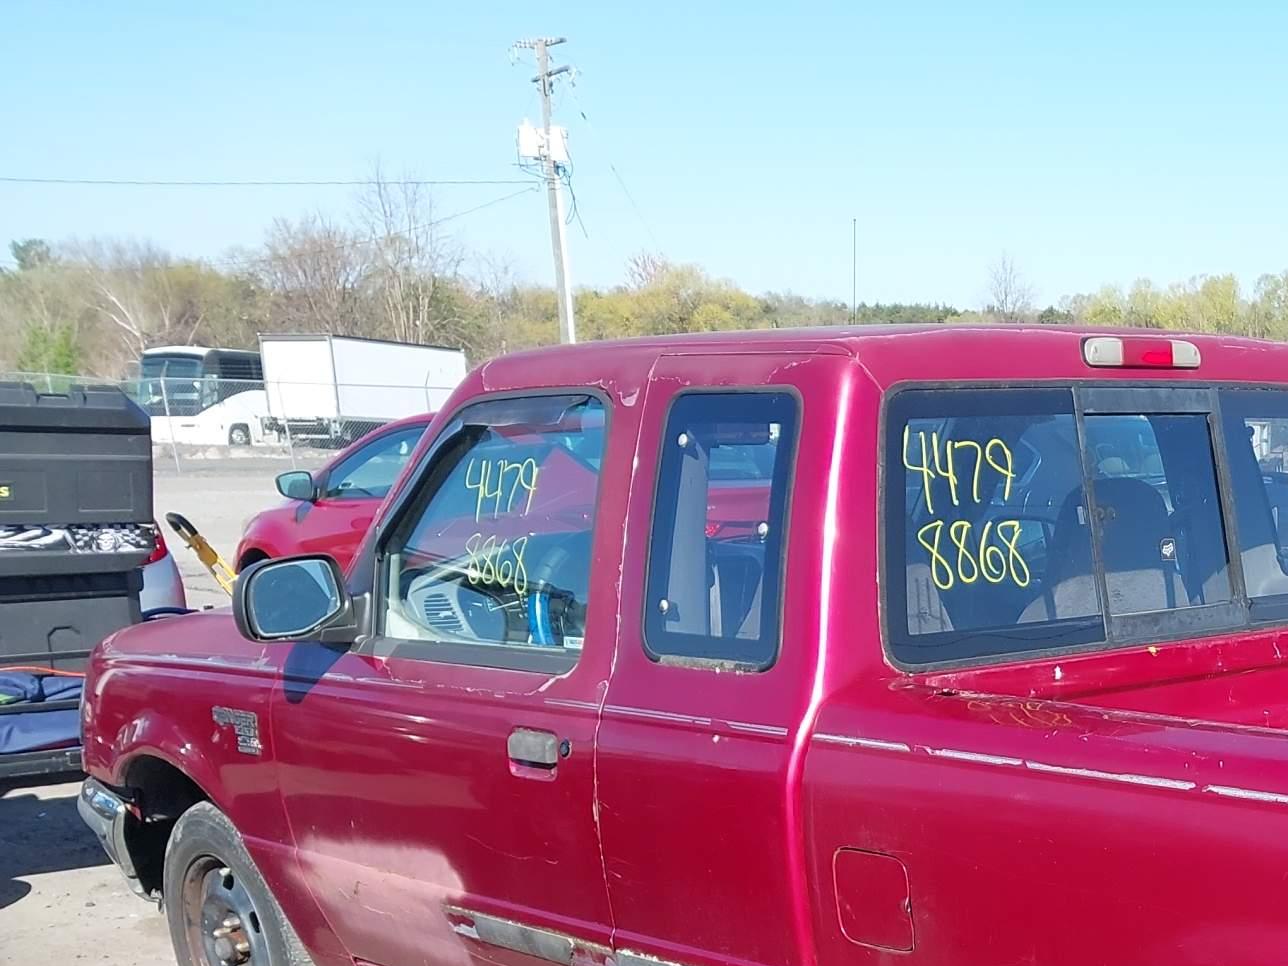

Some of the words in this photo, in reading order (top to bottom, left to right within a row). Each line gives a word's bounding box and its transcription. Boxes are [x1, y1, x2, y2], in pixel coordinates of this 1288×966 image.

[465, 457, 539, 524] 4479
[902, 425, 1016, 514] 4479
[465, 532, 529, 595] 8868
[917, 519, 1031, 590] 8868
